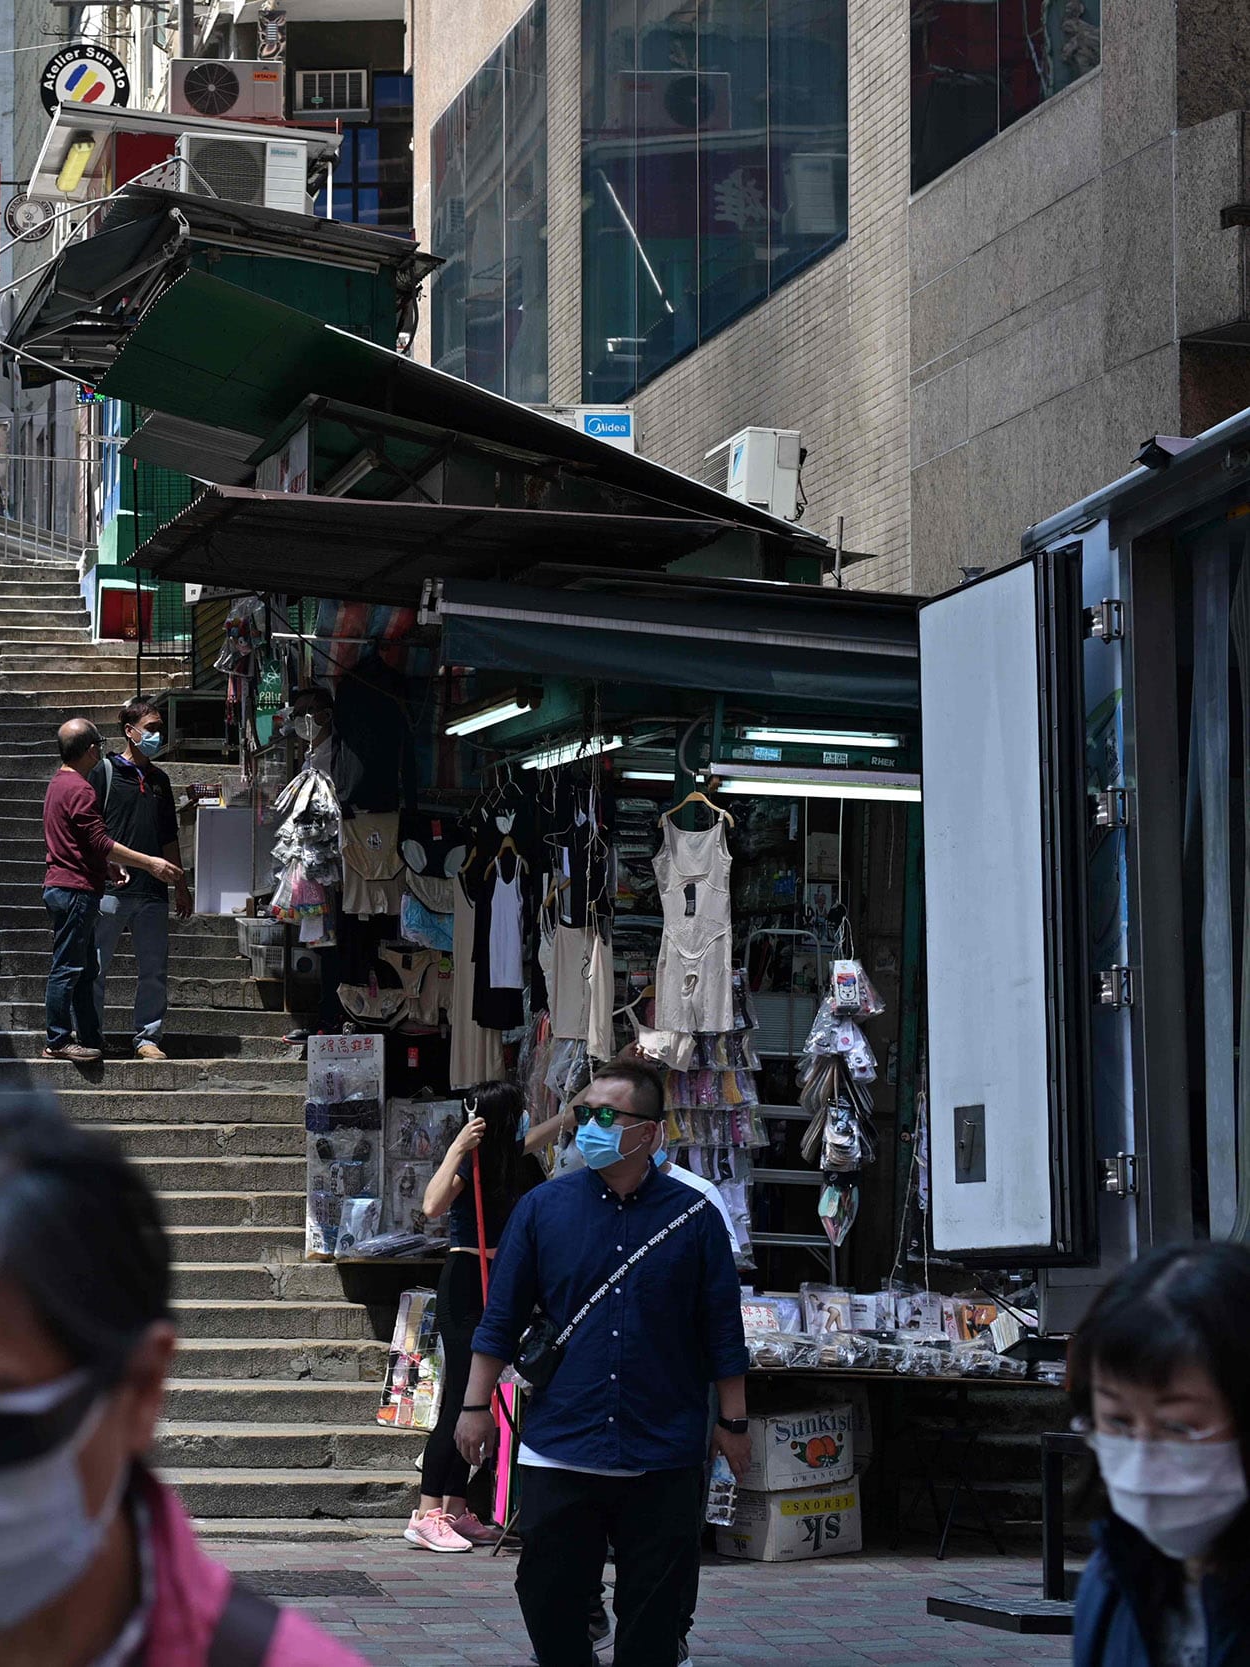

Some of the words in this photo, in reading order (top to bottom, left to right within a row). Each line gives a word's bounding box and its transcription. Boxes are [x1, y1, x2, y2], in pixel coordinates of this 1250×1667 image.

[43, 49, 81, 91] Atelier
[85, 47, 113, 67] Sun
[112, 67, 126, 89] Ho
[591, 419, 627, 434] Midea
[687, 1198, 707, 1215] adidas
[667, 1212, 689, 1230] adidas
[647, 1228, 669, 1247] adidas
[627, 1244, 649, 1264] adidas
[608, 1263, 629, 1284] adidas
[589, 1282, 609, 1304] adidas
[571, 1302, 590, 1325] adidas
[555, 1324, 573, 1346] adidas
[774, 1410, 854, 1445] Sunkist
[792, 1467, 849, 1483] ORANGES
[792, 1497, 850, 1512] LEMONS
